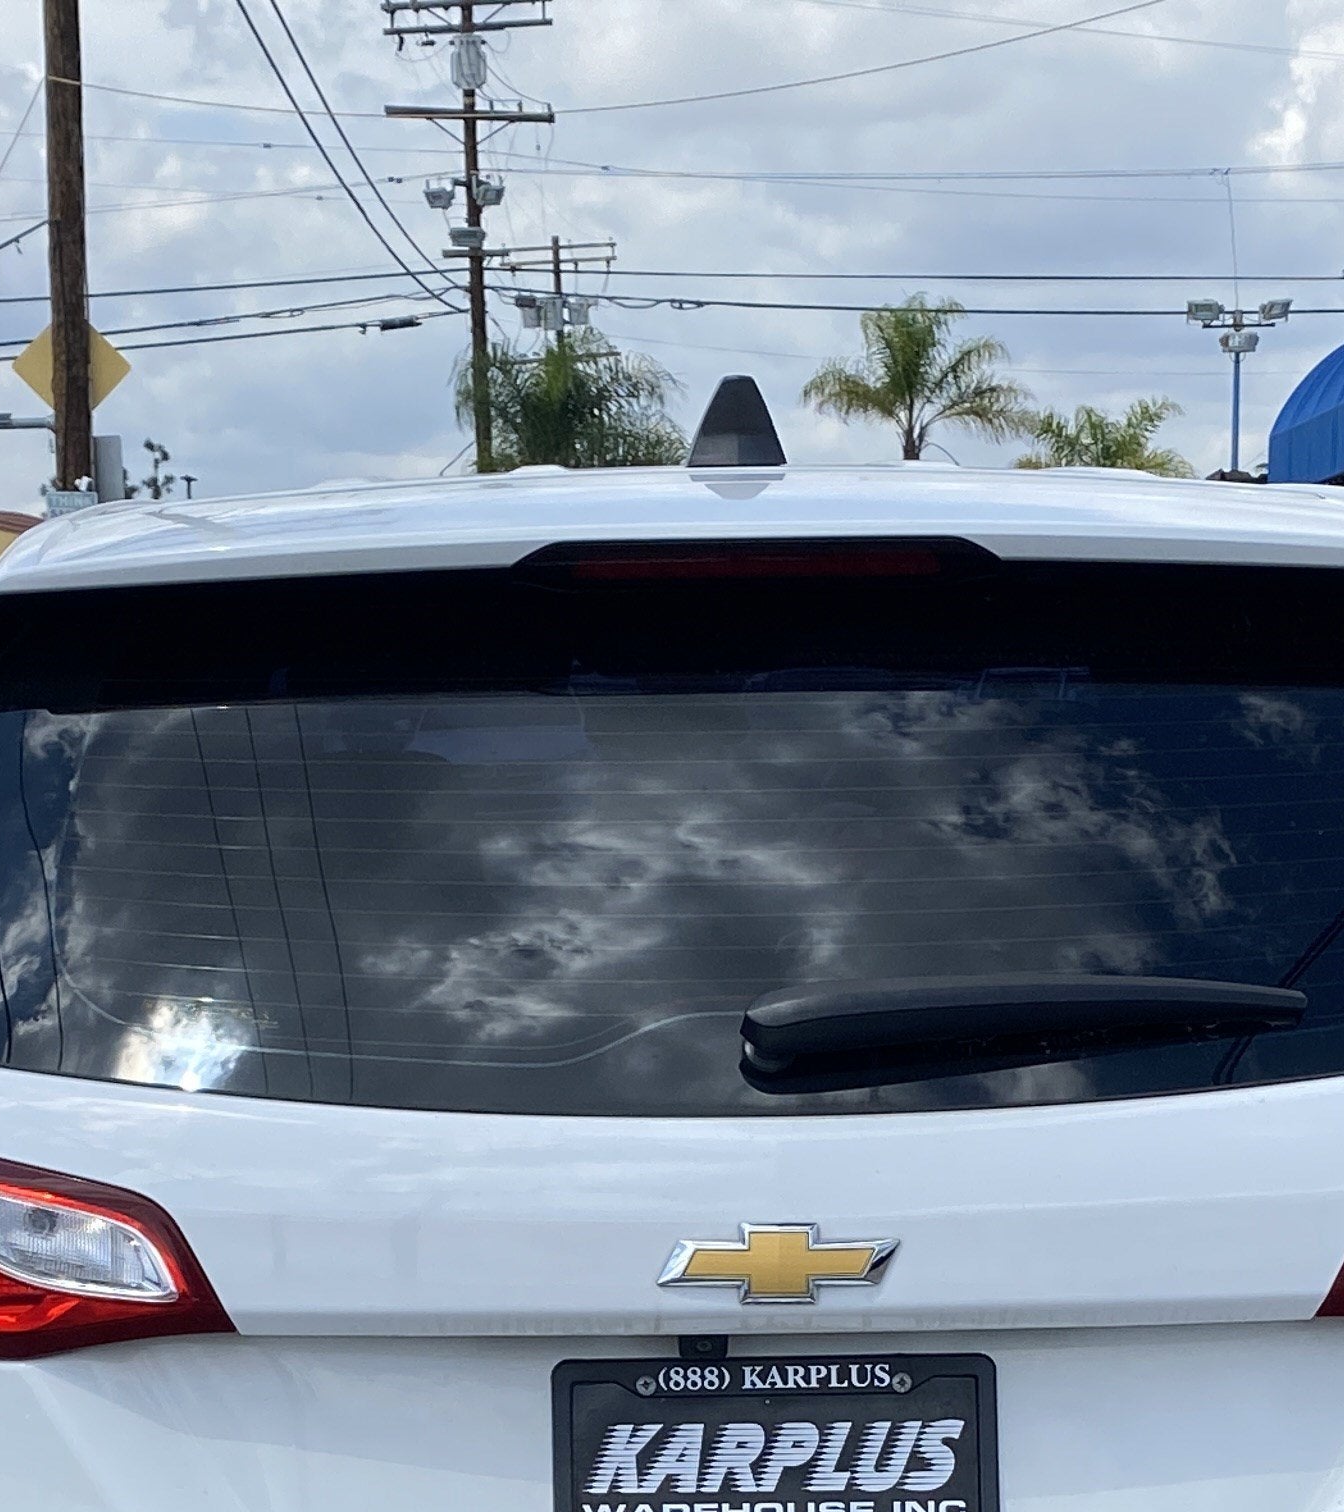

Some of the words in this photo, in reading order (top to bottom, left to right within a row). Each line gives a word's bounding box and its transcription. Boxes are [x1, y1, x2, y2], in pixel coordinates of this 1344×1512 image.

[657, 1366, 731, 1392] (888)
[741, 1363, 892, 1391] KARPLUS
[582, 1418, 966, 1494] KARPLUS
